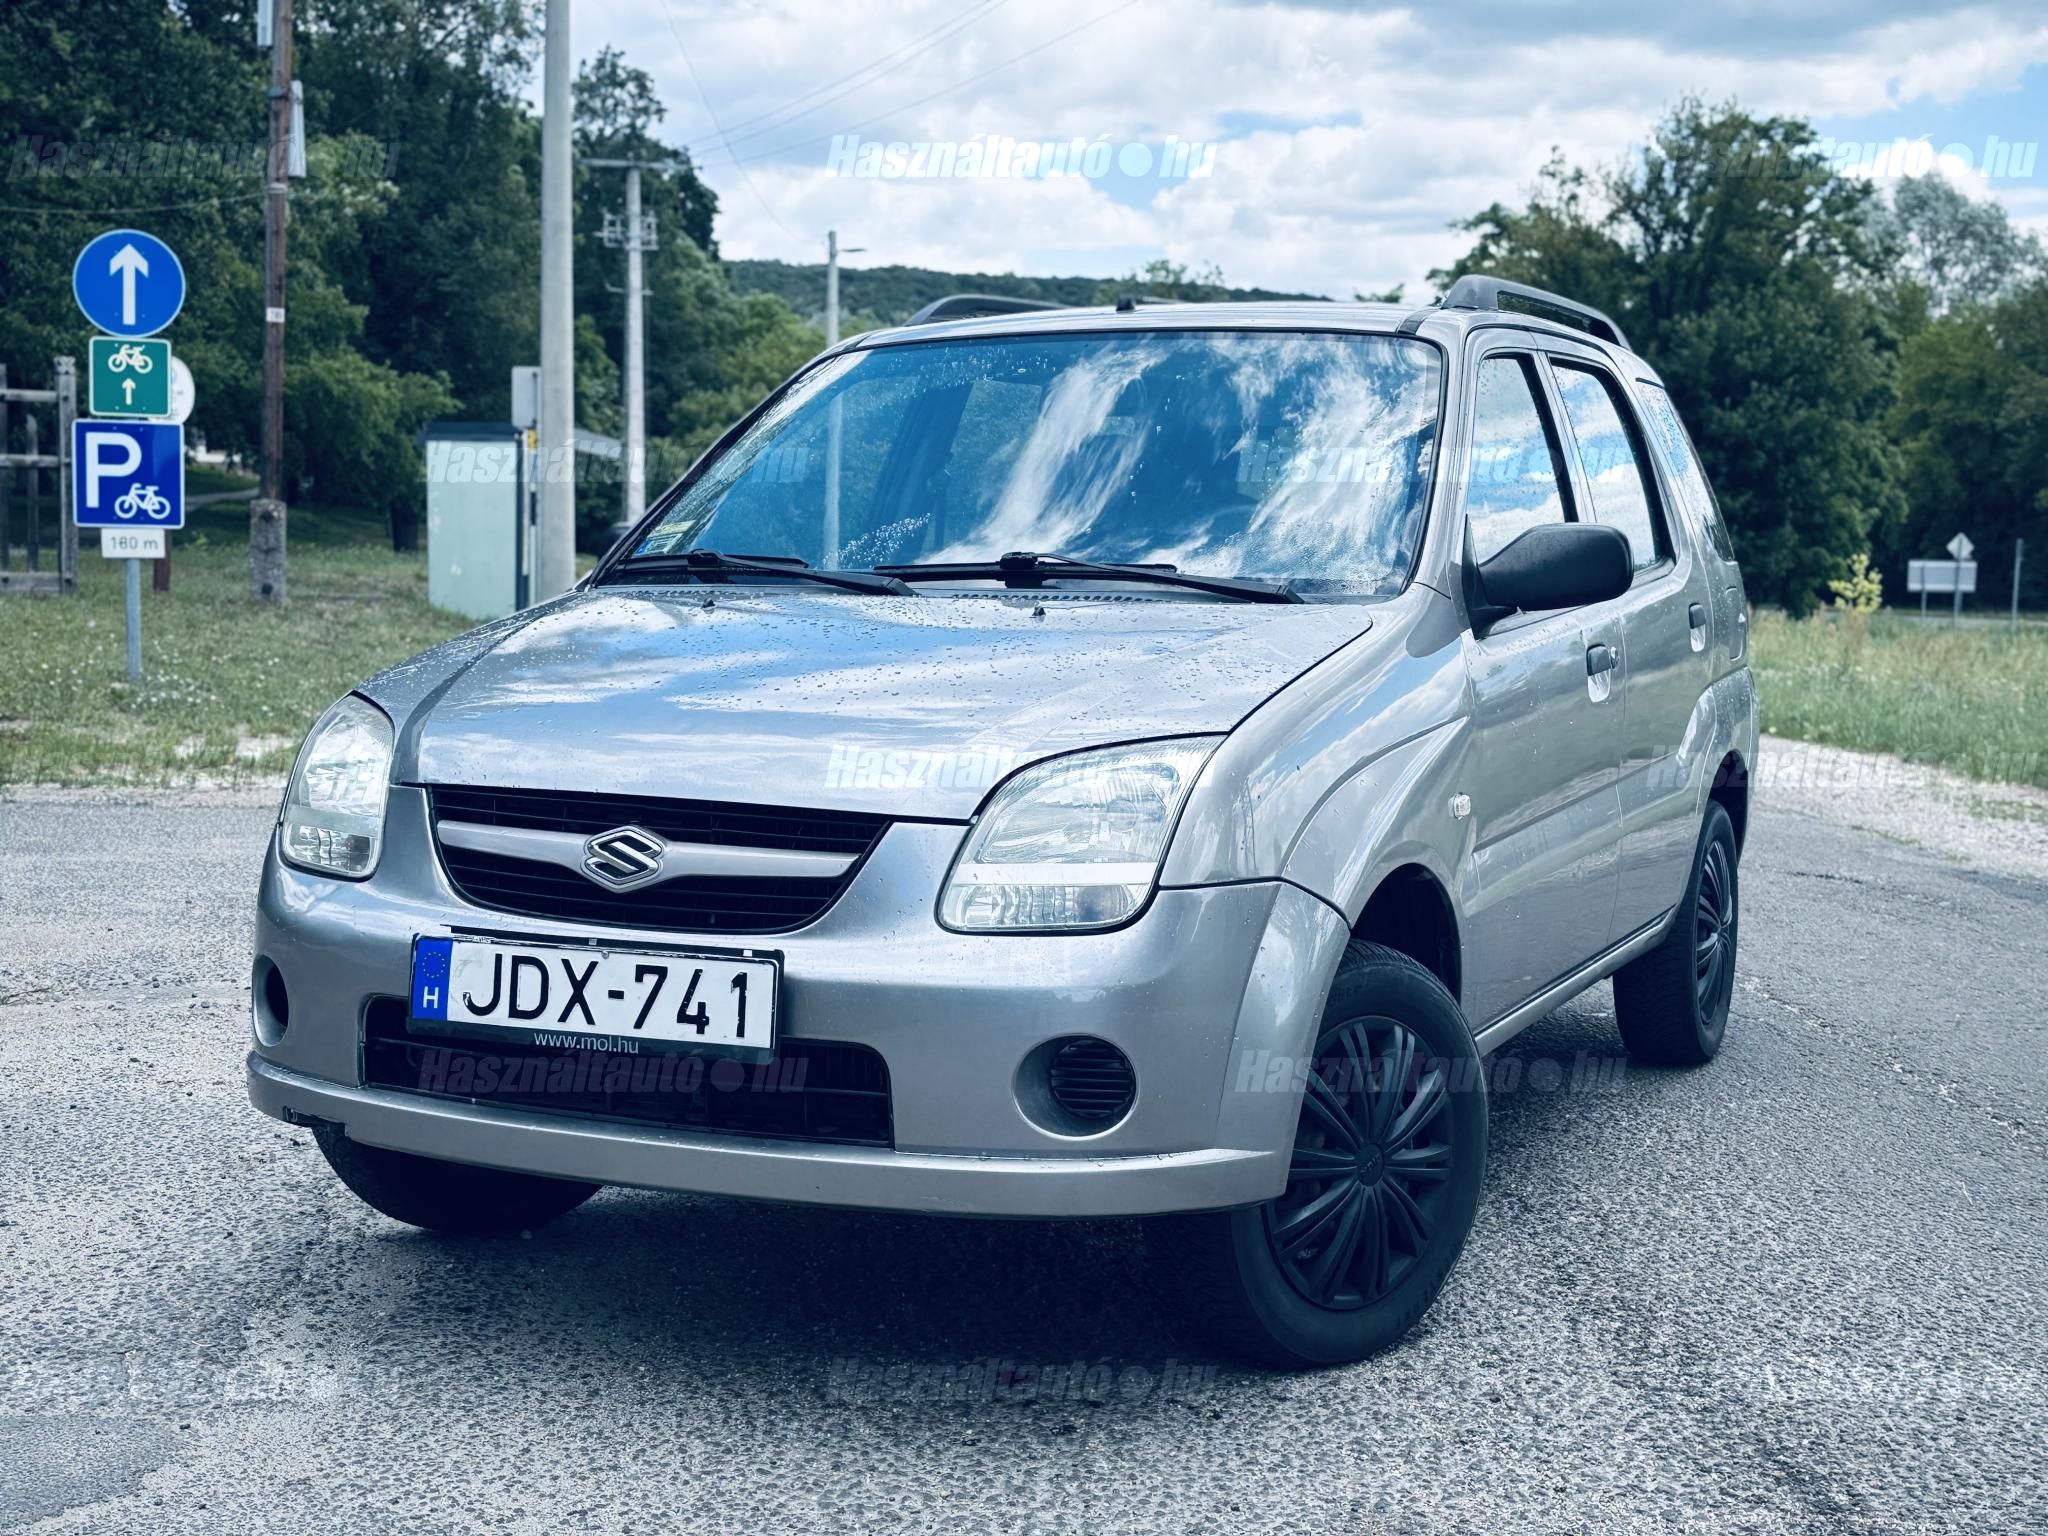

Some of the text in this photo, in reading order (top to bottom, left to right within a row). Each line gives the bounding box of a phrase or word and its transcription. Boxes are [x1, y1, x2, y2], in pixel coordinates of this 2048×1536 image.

[86, 432, 142, 508] P
[144, 540, 159, 550] m
[423, 953, 748, 1038] H JDX-741
[533, 1031, 639, 1055] www.mol.hu
